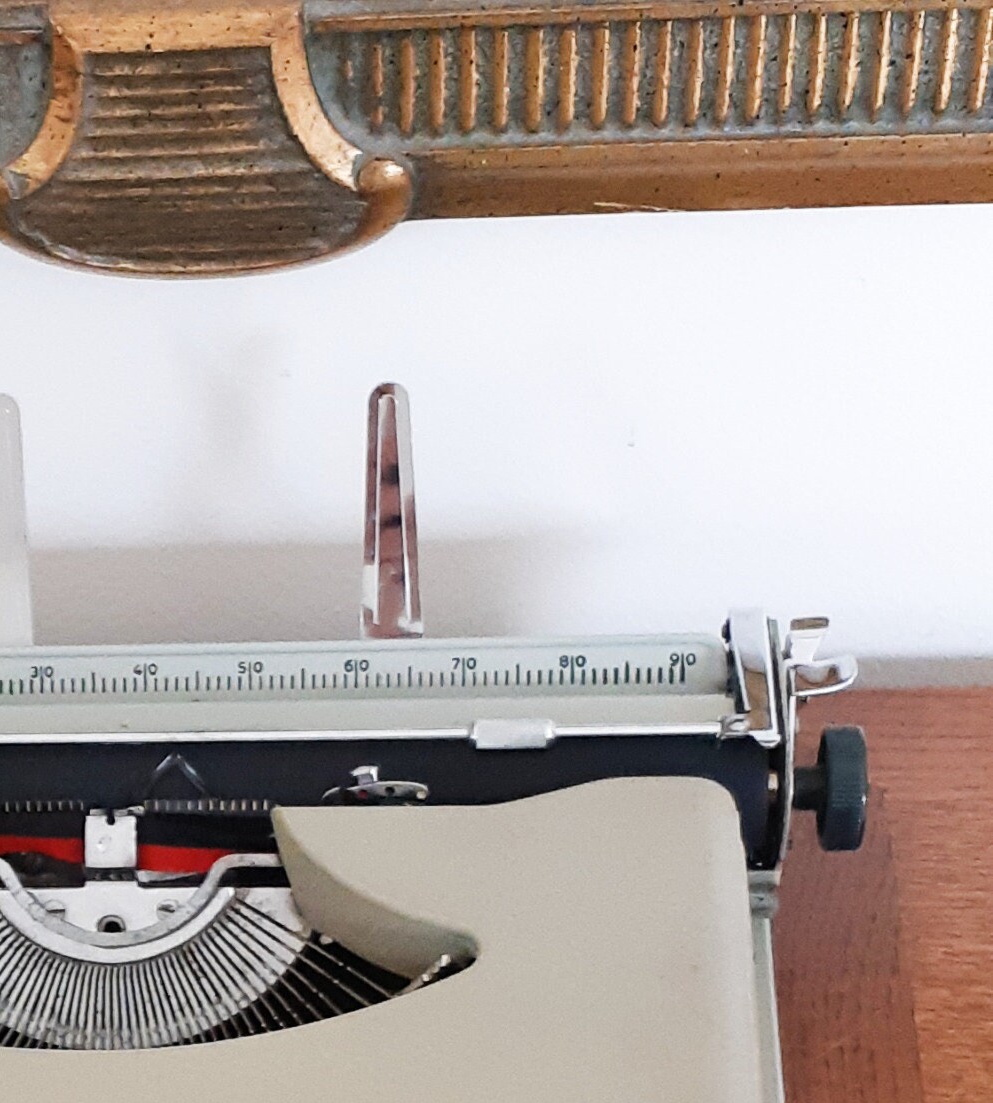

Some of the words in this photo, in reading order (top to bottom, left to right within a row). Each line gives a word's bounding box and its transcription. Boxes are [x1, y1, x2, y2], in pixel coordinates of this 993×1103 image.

[30, 665, 54, 679] 30
[132, 663, 158, 676] 40
[238, 661, 264, 674] 50
[343, 659, 370, 673] 60
[451, 657, 477, 671] 70
[559, 655, 587, 669] 80
[669, 653, 697, 667] 90
